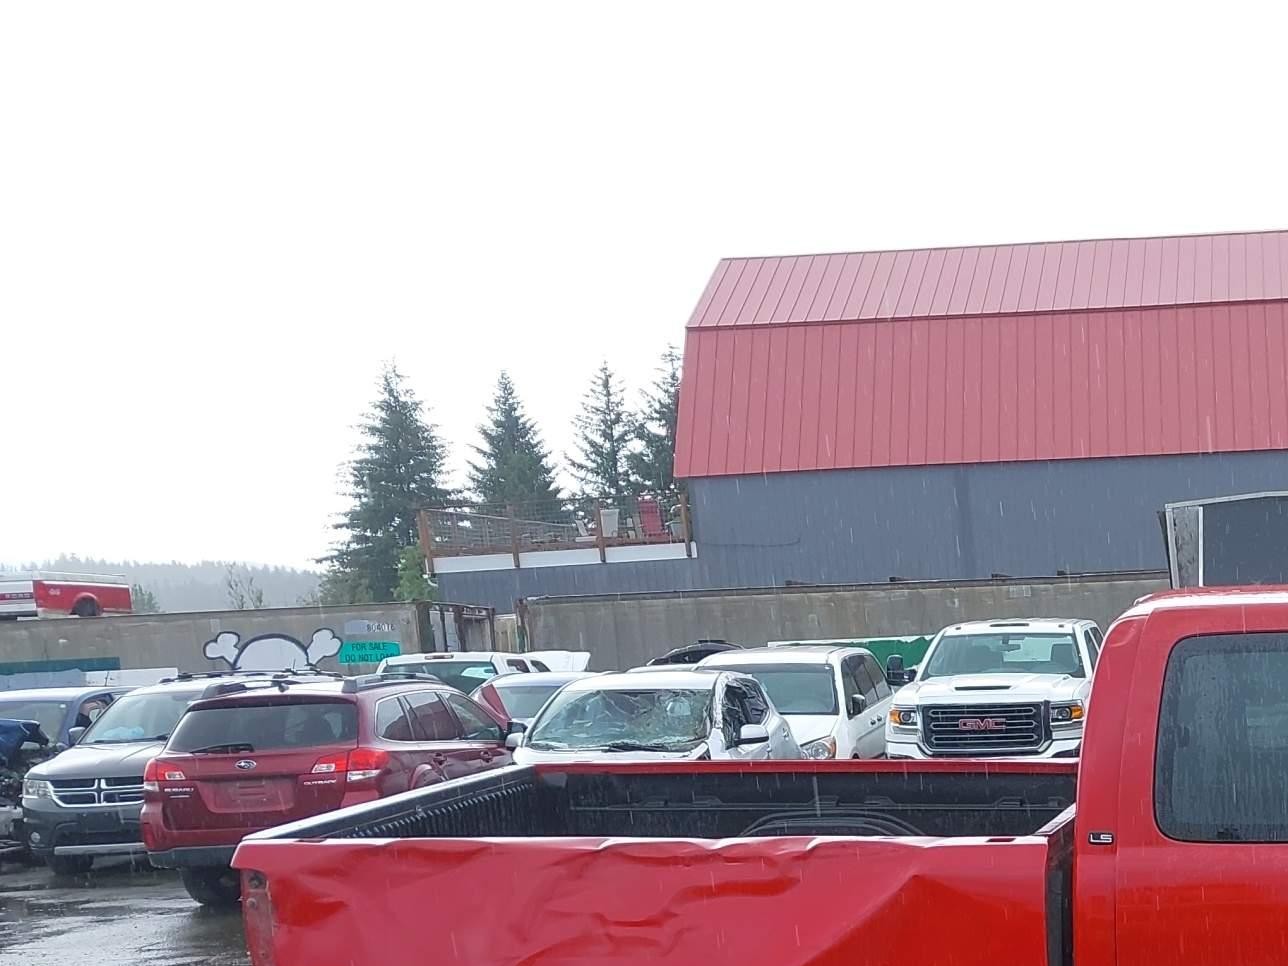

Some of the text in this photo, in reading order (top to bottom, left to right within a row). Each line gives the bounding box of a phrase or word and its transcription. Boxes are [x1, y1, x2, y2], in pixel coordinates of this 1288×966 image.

[351, 642, 388, 651] FOR SALE
[344, 654, 357, 663] DO
[358, 653, 373, 663] NOT
[958, 718, 1007, 730] GMC
[1090, 833, 1113, 843] LS
